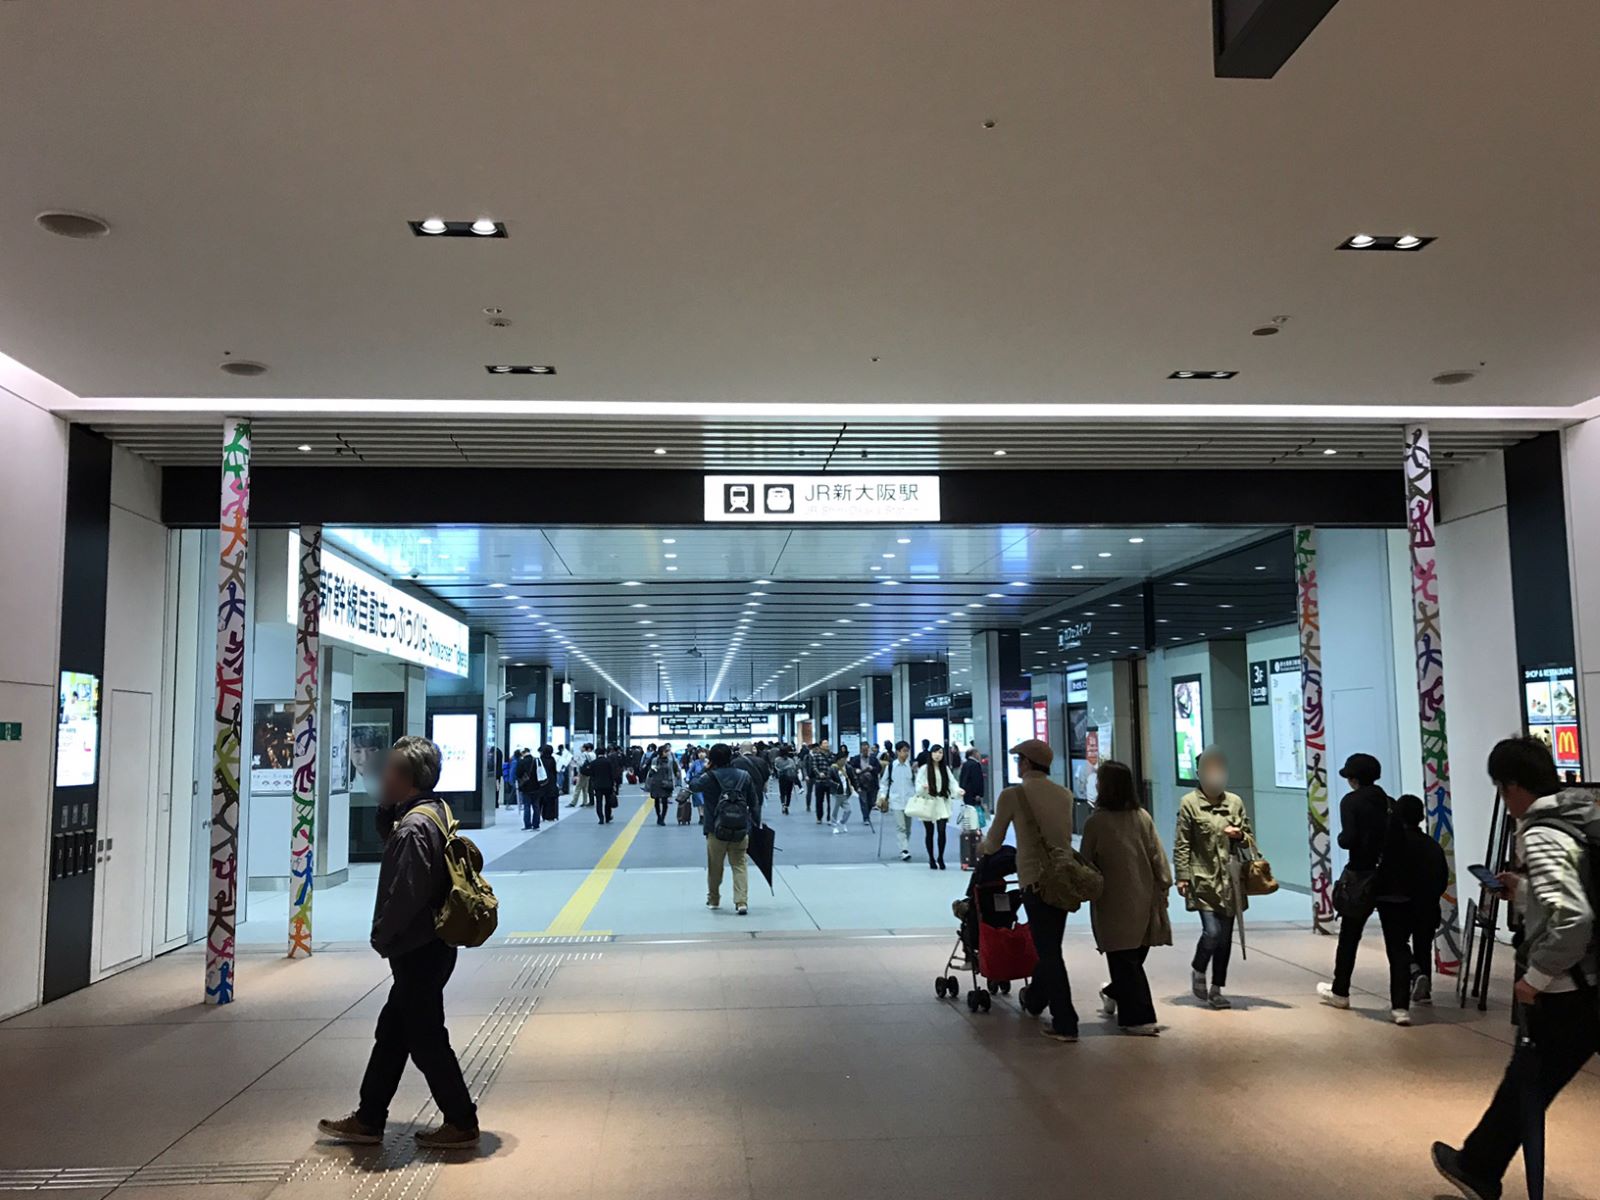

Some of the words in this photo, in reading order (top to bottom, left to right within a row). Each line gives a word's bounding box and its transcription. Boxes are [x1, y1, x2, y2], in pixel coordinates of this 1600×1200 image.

[804, 483, 919, 502] JR新大阪駅
[1253, 665, 1264, 683] 3F
